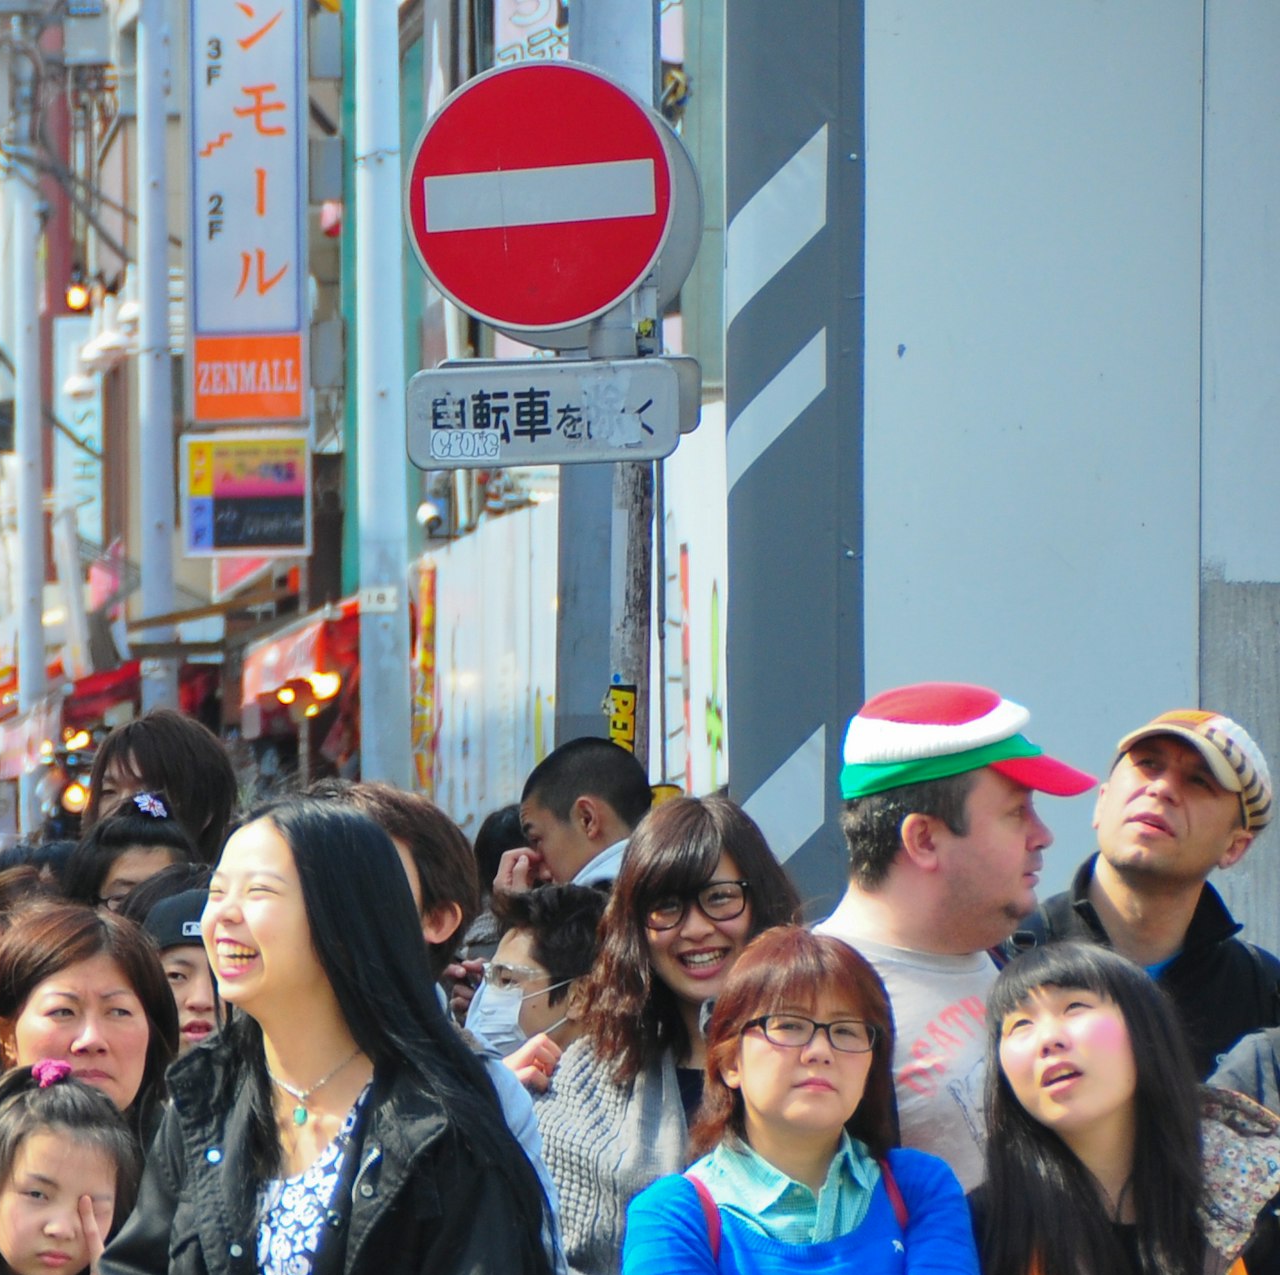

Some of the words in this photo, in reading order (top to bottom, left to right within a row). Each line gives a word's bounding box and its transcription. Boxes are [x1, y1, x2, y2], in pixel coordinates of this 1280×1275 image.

[207, 195, 224, 240] 2F
[198, 359, 299, 396] ZENMALL
[431, 387, 655, 447] 自転車をく
